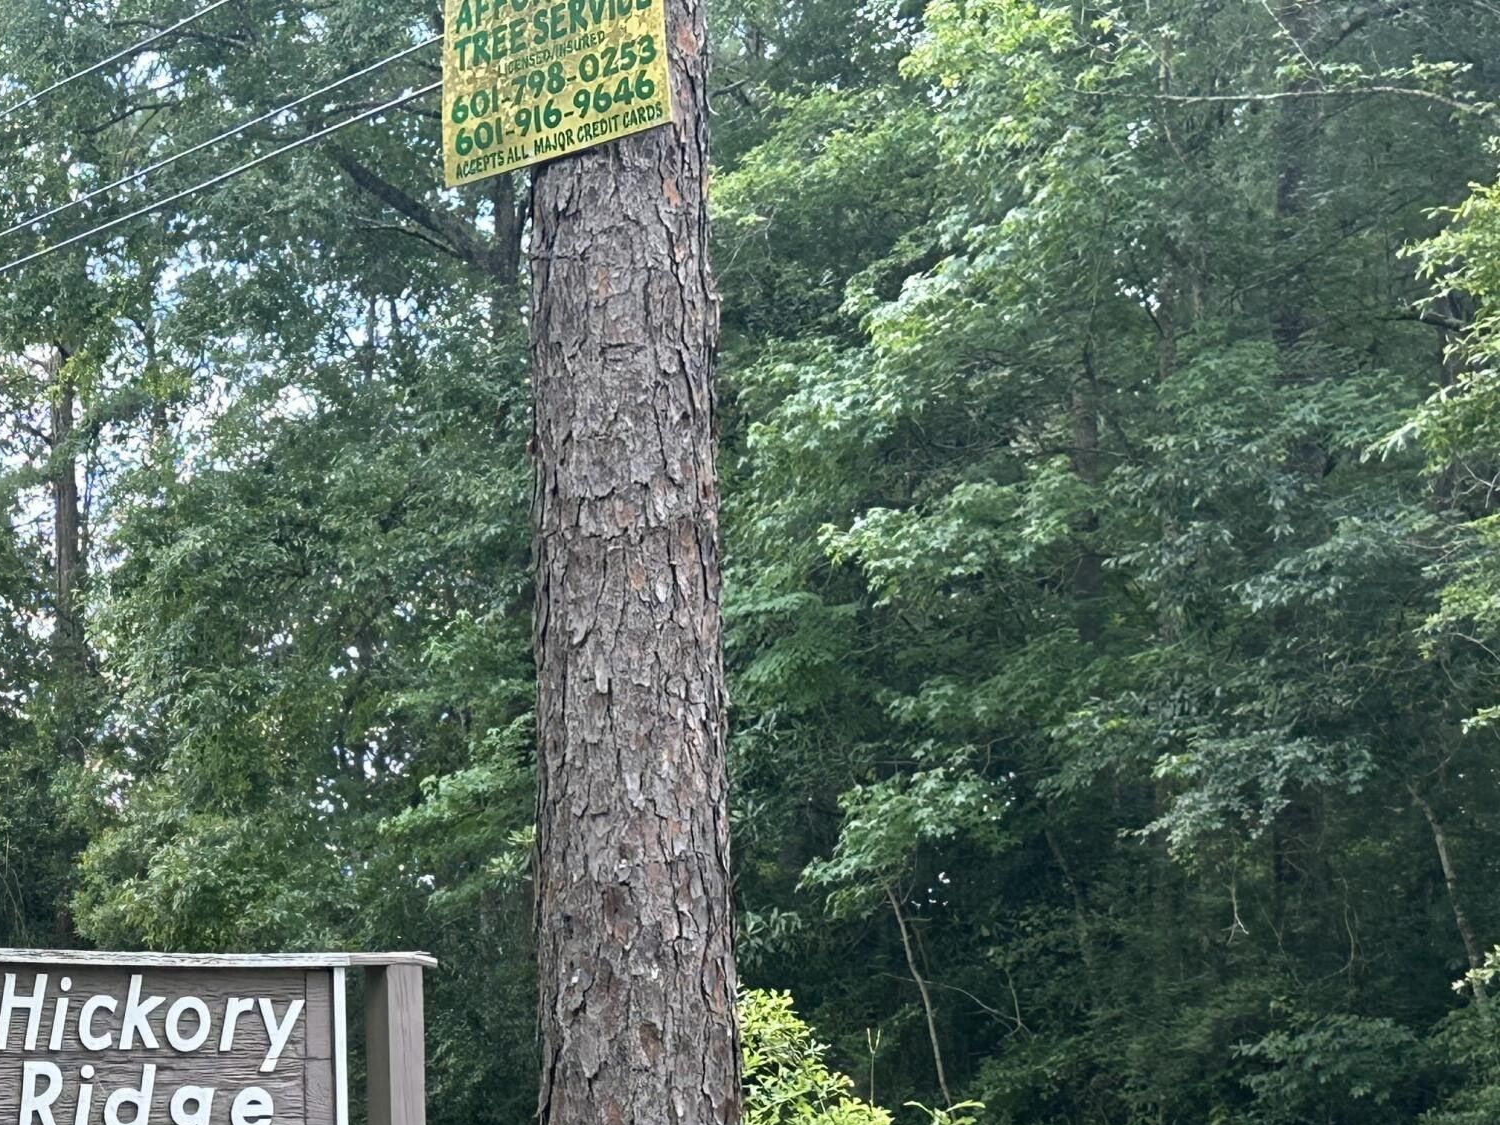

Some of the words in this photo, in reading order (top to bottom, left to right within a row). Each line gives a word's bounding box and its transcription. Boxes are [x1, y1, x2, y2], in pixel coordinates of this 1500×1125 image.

[453, 17, 527, 71] TREE
[533, 0, 652, 45] SERVI
[451, 33, 657, 124] 601-798-0253
[455, 69, 655, 156] 601-916-9646
[456, 150, 504, 179] ACCEPTS
[507, 145, 529, 164] ALL
[534, 128, 575, 156] MAJOR
[577, 114, 620, 143] CREDIT
[622, 101, 663, 128] CARDS
